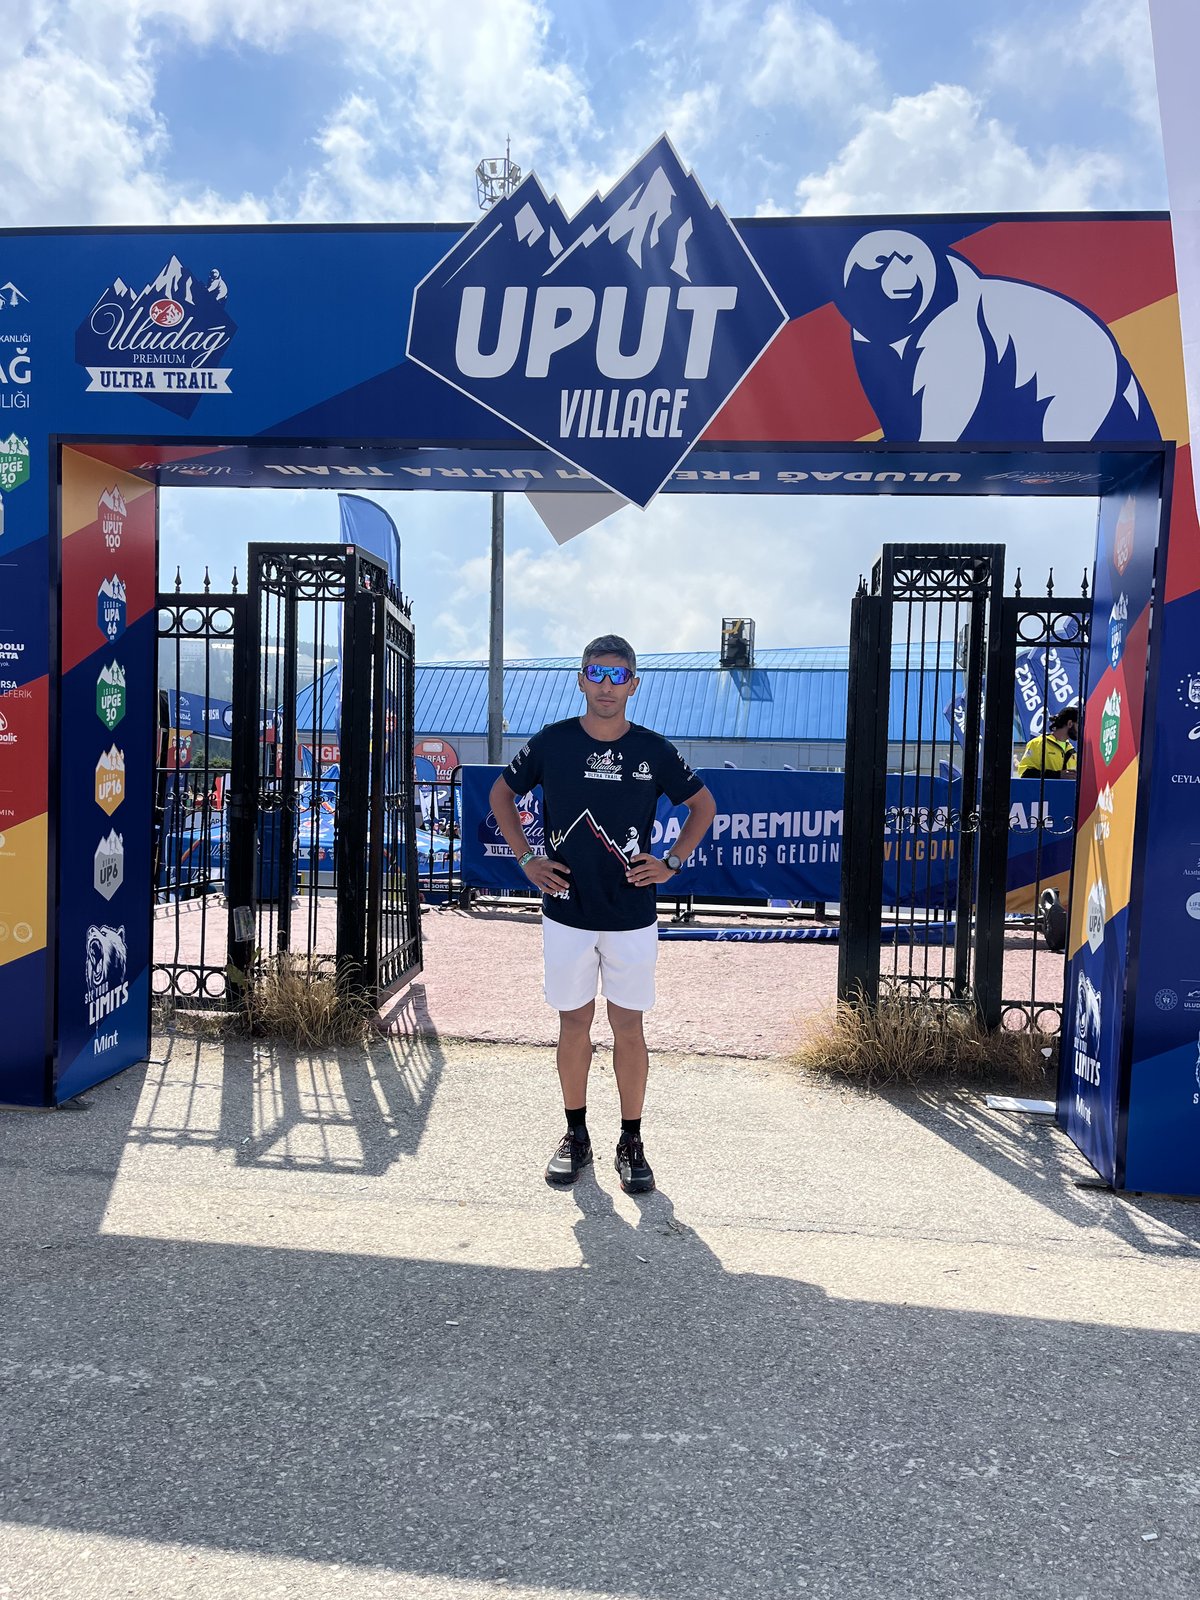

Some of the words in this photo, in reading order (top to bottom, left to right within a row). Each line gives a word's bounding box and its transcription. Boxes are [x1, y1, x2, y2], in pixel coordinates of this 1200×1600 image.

[90, 303, 227, 368] Uludağ
[455, 286, 738, 385] UPUT
[132, 353, 185, 364] PREMIUM
[100, 371, 155, 389] ULTRA
[163, 372, 217, 389] TRAIL
[559, 388, 688, 438] VILLAGE
[0, 462, 23, 474] PGE
[264, 465, 394, 476] TRAIL
[400, 467, 544, 479] ULTRA
[1, 473, 16, 484] 30
[778, 472, 961, 483] ULUDAĞ
[103, 520, 123, 535] UPUT
[105, 534, 121, 548] 100
[104, 609, 120, 622] UPA
[107, 623, 117, 635] 66
[102, 694, 122, 710] UPGE
[106, 709, 117, 722] 30
[1105, 741, 1113, 757] 30
[99, 780, 122, 800] UP16
[712, 809, 844, 841] PREMIUM
[733, 845, 768, 869] HOŞ
[100, 864, 118, 885] UP6
[1089, 915, 1101, 933] UP6
[89, 980, 129, 1025] LIMITS
[94, 1029, 119, 1055] Mint
[1075, 1050, 1101, 1087] LIMITS
